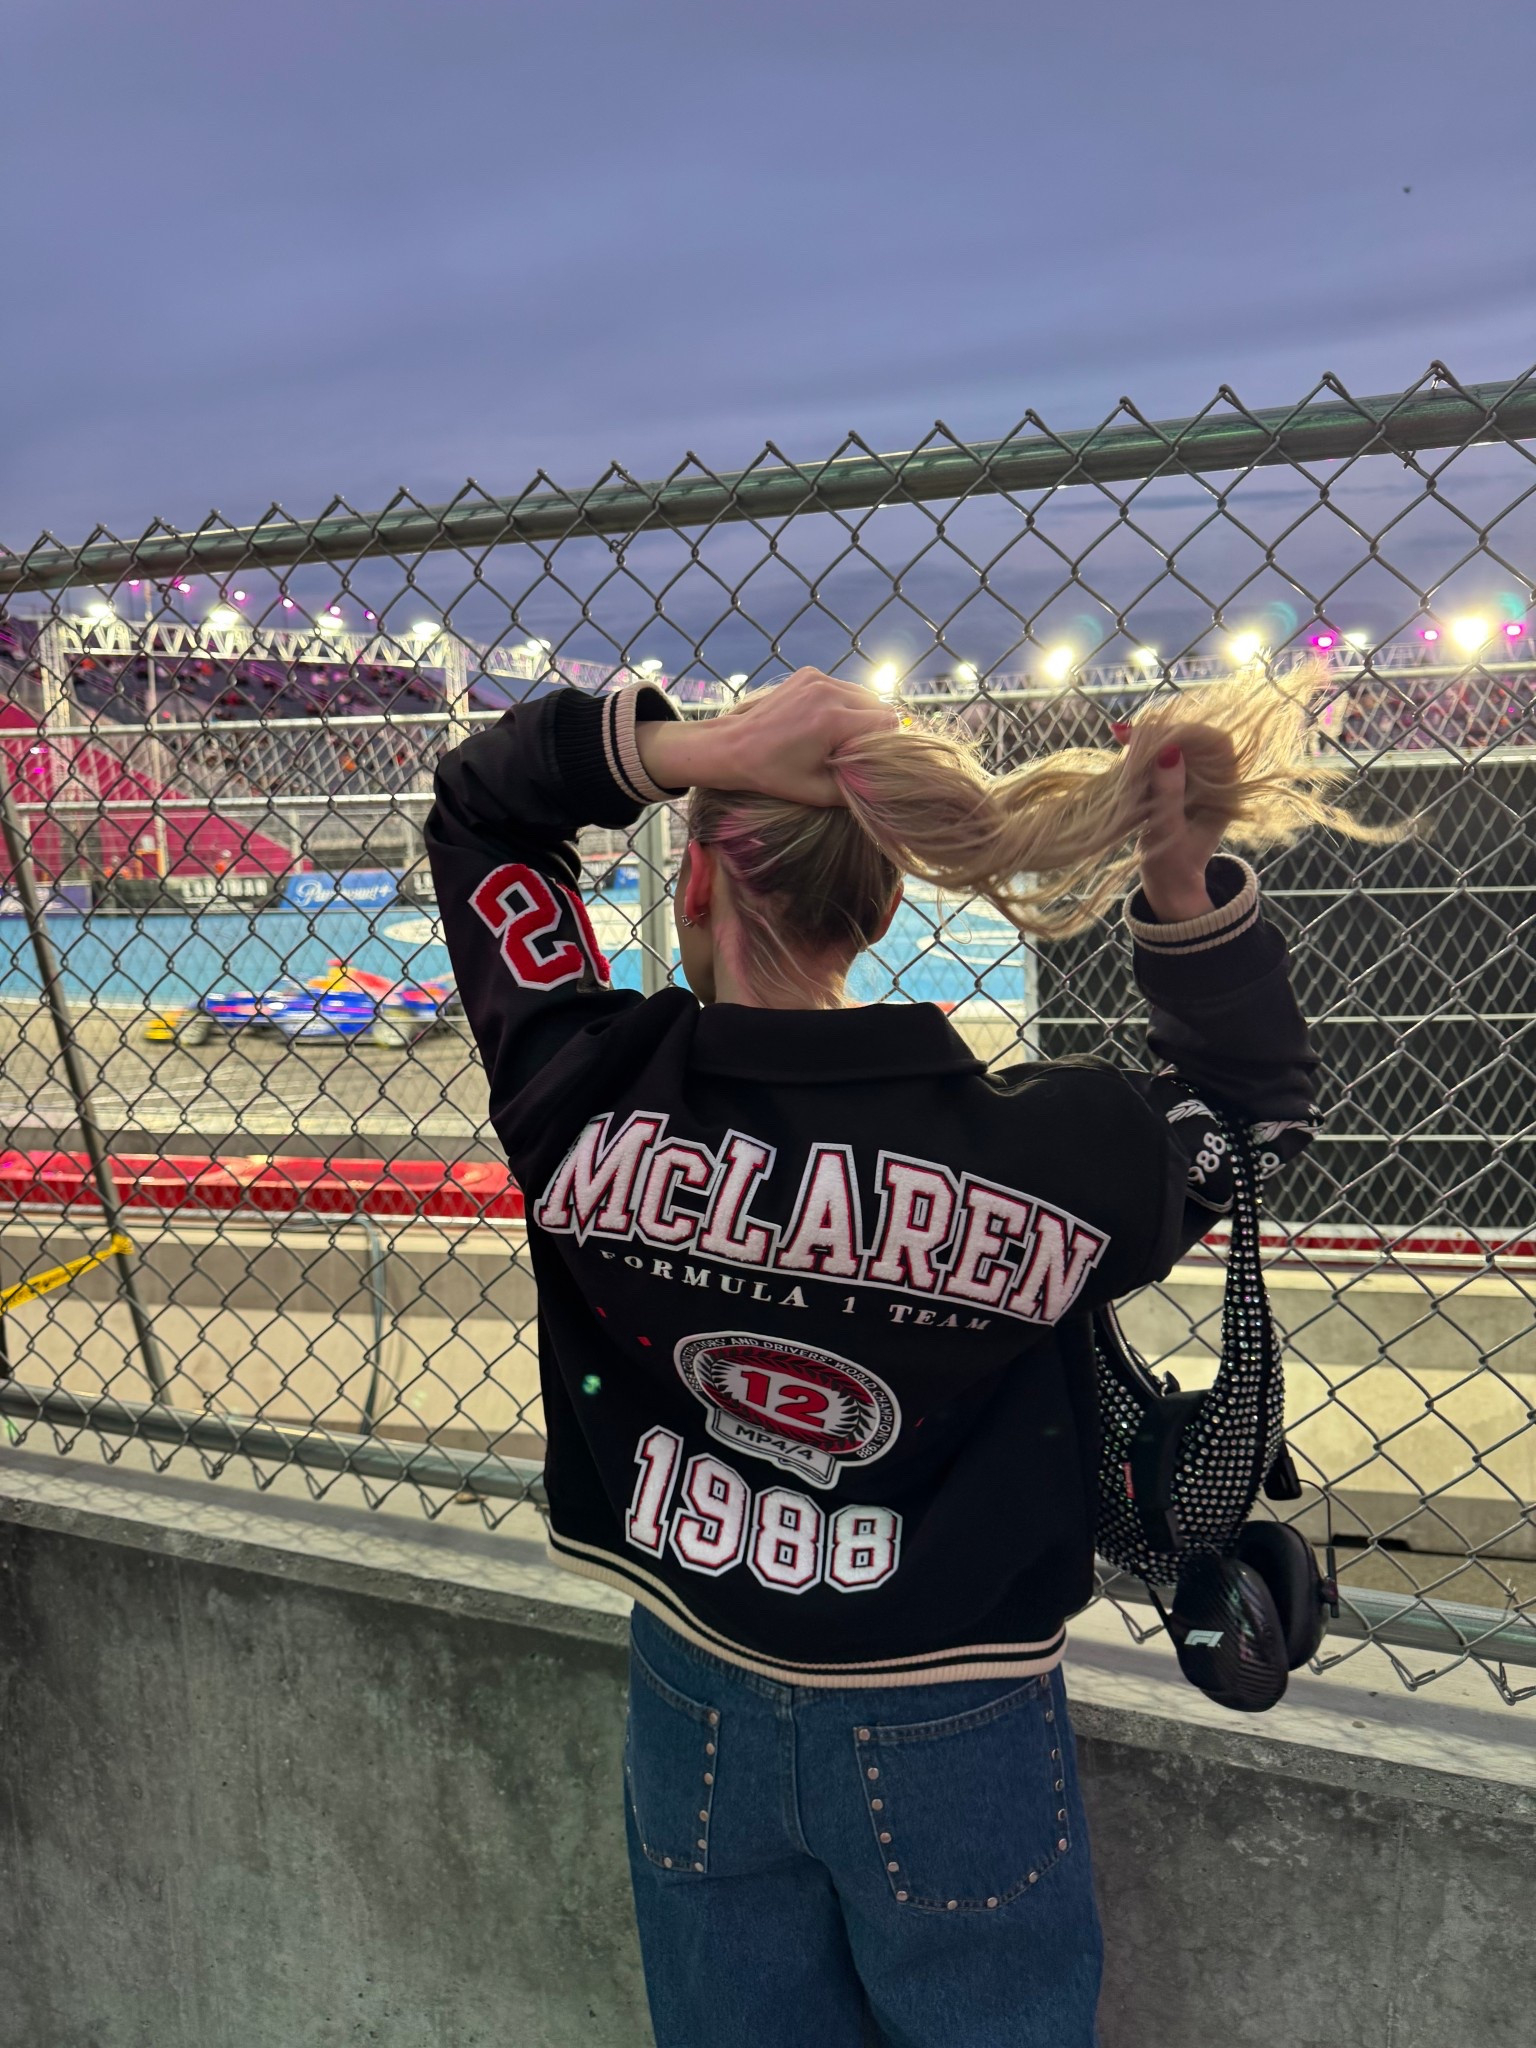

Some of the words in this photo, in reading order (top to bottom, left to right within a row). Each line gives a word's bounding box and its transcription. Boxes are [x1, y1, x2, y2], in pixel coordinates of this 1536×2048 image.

[600, 1249, 809, 1309] FORMULA
[840, 1296, 857, 1315] 1
[888, 1303, 993, 1331] TEAM
[730, 1336, 760, 1347] AND
[834, 1361, 877, 1390] WORLD
[872, 1389, 895, 1443] CHAMPIONS
[740, 1370, 830, 1429] 12
[734, 1423, 815, 1462] MP4/4
[625, 1424, 903, 1595] 1988
